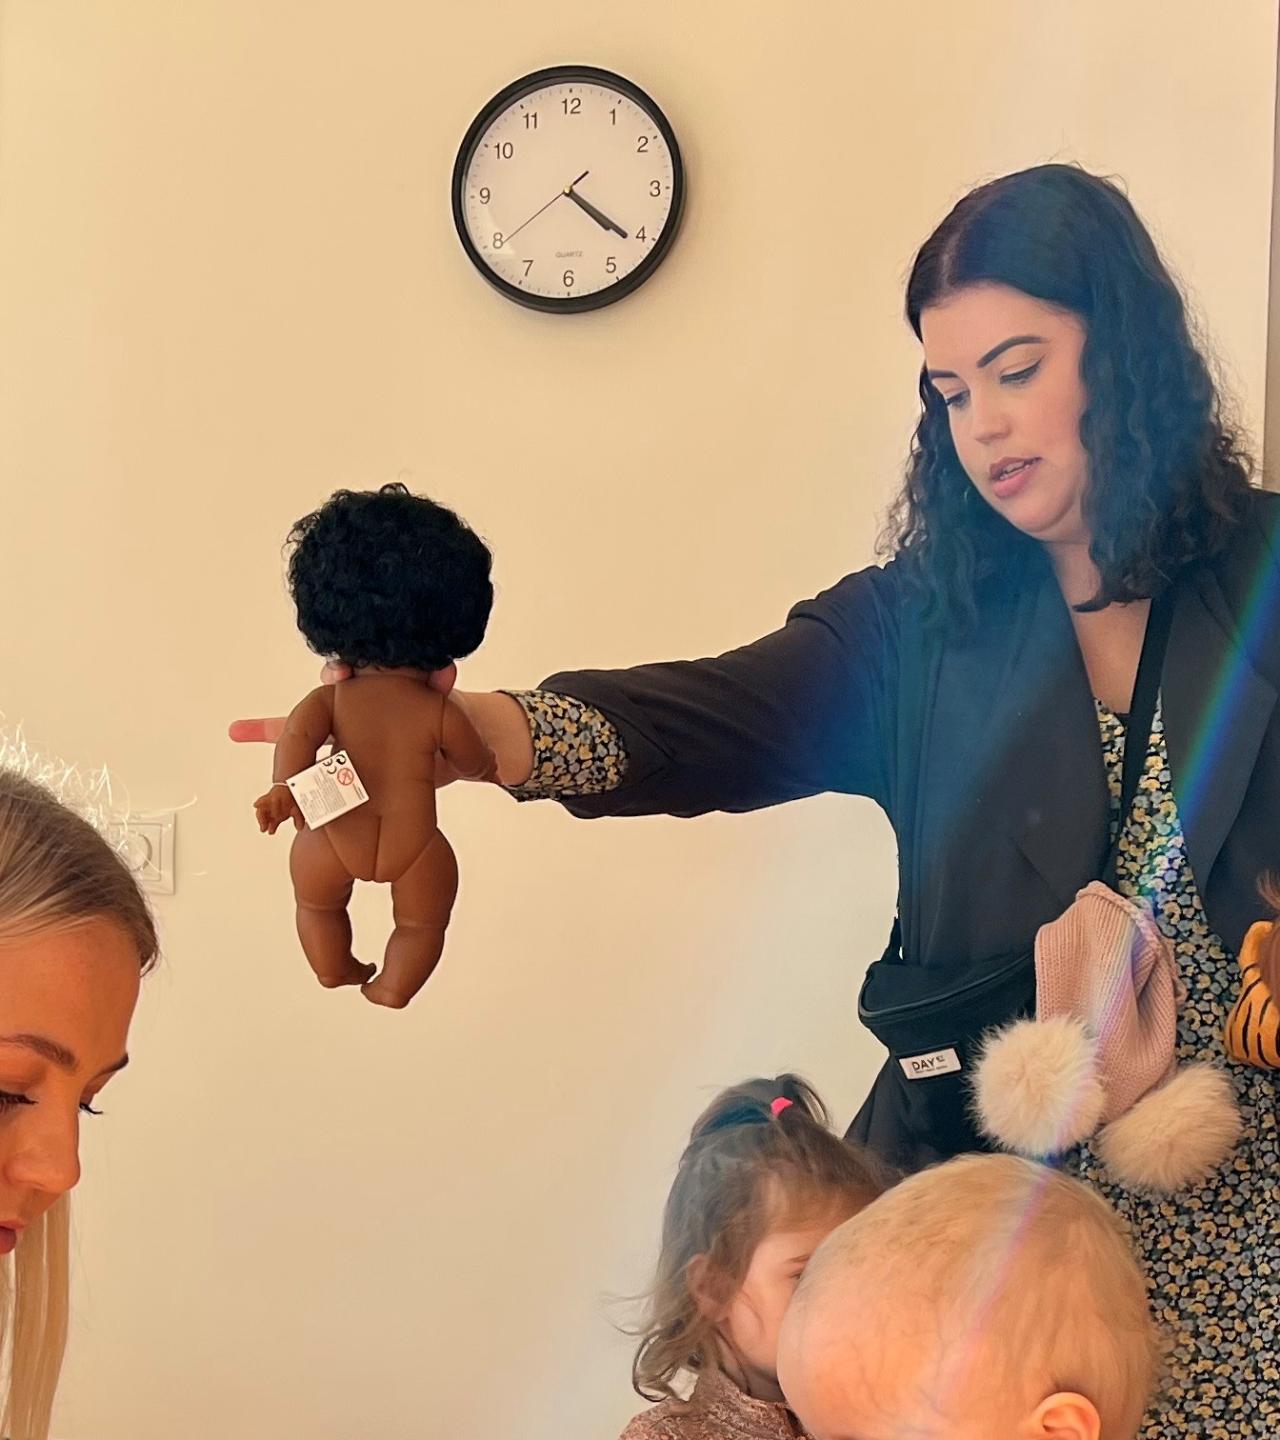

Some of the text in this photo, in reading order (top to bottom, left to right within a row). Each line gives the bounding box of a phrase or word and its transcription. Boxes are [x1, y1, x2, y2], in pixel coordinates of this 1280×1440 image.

[562, 98, 581, 114] 12
[523, 112, 538, 129] 11
[609, 109, 616, 125] 1
[494, 142, 514, 159] 10
[637, 136, 649, 153] 2
[479, 188, 491, 204] 9
[649, 180, 661, 197] 3
[492, 232, 504, 249] 8
[635, 226, 647, 242] 4
[522, 260, 534, 276] 7
[605, 257, 617, 273] 5
[563, 270, 574, 287] 6
